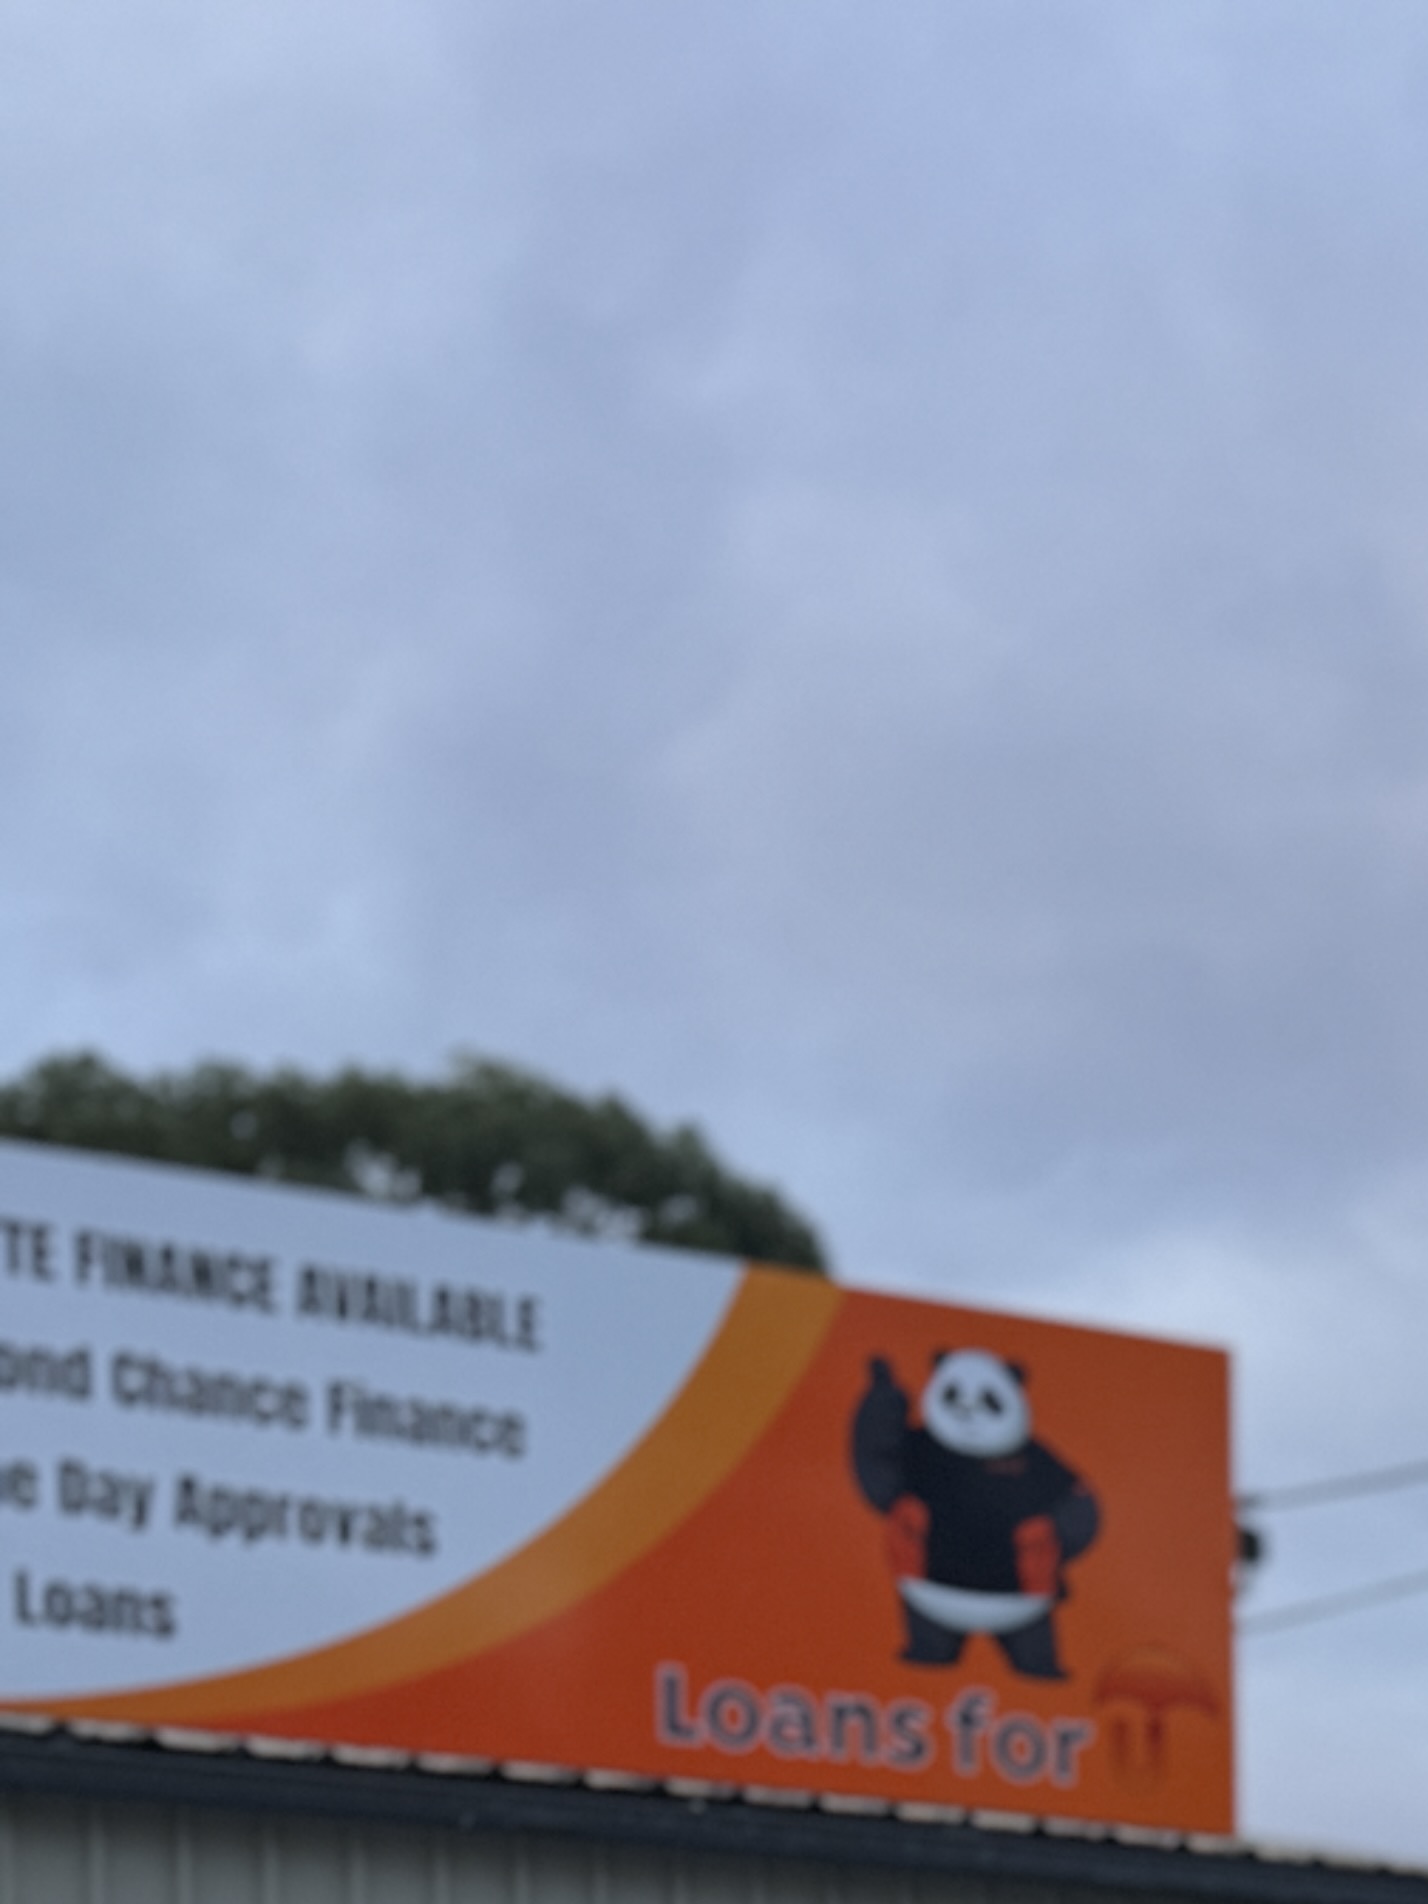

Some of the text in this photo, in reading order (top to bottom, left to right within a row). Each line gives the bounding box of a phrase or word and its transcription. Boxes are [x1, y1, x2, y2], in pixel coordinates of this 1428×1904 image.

[74, 1230, 274, 1315] FINANCE
[298, 1263, 541, 1353] AVAILABLE
[112, 1350, 308, 1428] Chance
[326, 1380, 527, 1461] Finance
[59, 1458, 152, 1531] Day
[175, 1474, 437, 1560] Approvals
[15, 1569, 176, 1639] Loans
[656, 1662, 931, 1769] Loans
[948, 1685, 1095, 1787] for
